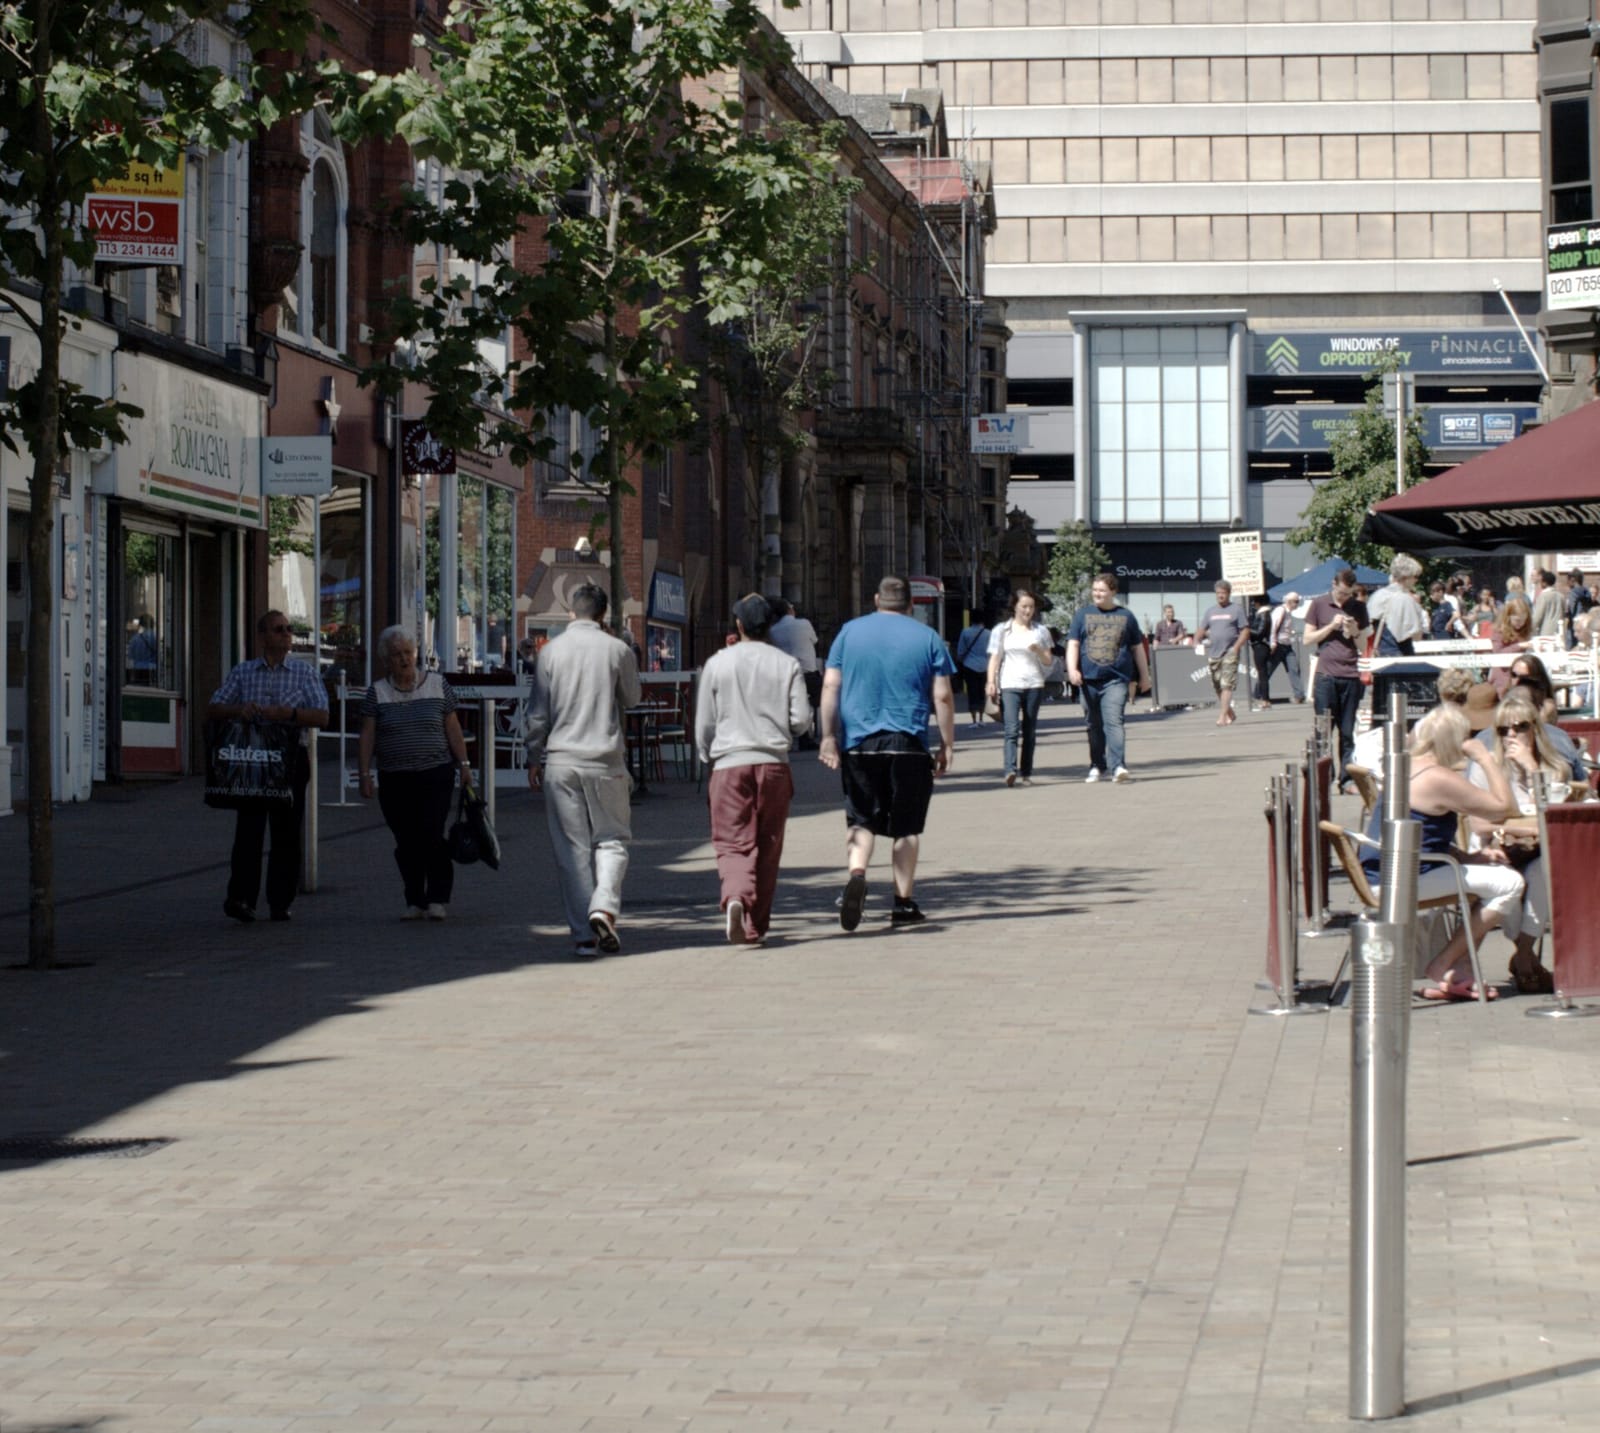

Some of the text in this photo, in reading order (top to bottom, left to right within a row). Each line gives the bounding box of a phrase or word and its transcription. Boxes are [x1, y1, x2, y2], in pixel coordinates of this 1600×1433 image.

[135, 172, 149, 185] sq
[153, 170, 163, 183] ft
[91, 200, 154, 232] wsb
[98, 242, 175, 257] 113 234 1444
[1549, 250, 1582, 270] SHOP
[1550, 278, 1572, 295] 020
[1330, 337, 1400, 351] WINDOWS OF
[183, 379, 218, 430] PASTA
[977, 418, 1015, 433] B&W
[1455, 417, 1477, 427] DTZ
[170, 423, 232, 480] ROMAGNA
[416, 440, 441, 457] PRET
[1443, 509, 1501, 534] FOR
[1488, 505, 1579, 527] COFFEE
[1115, 565, 1200, 580] Superdrug
[218, 743, 283, 763] slaters
